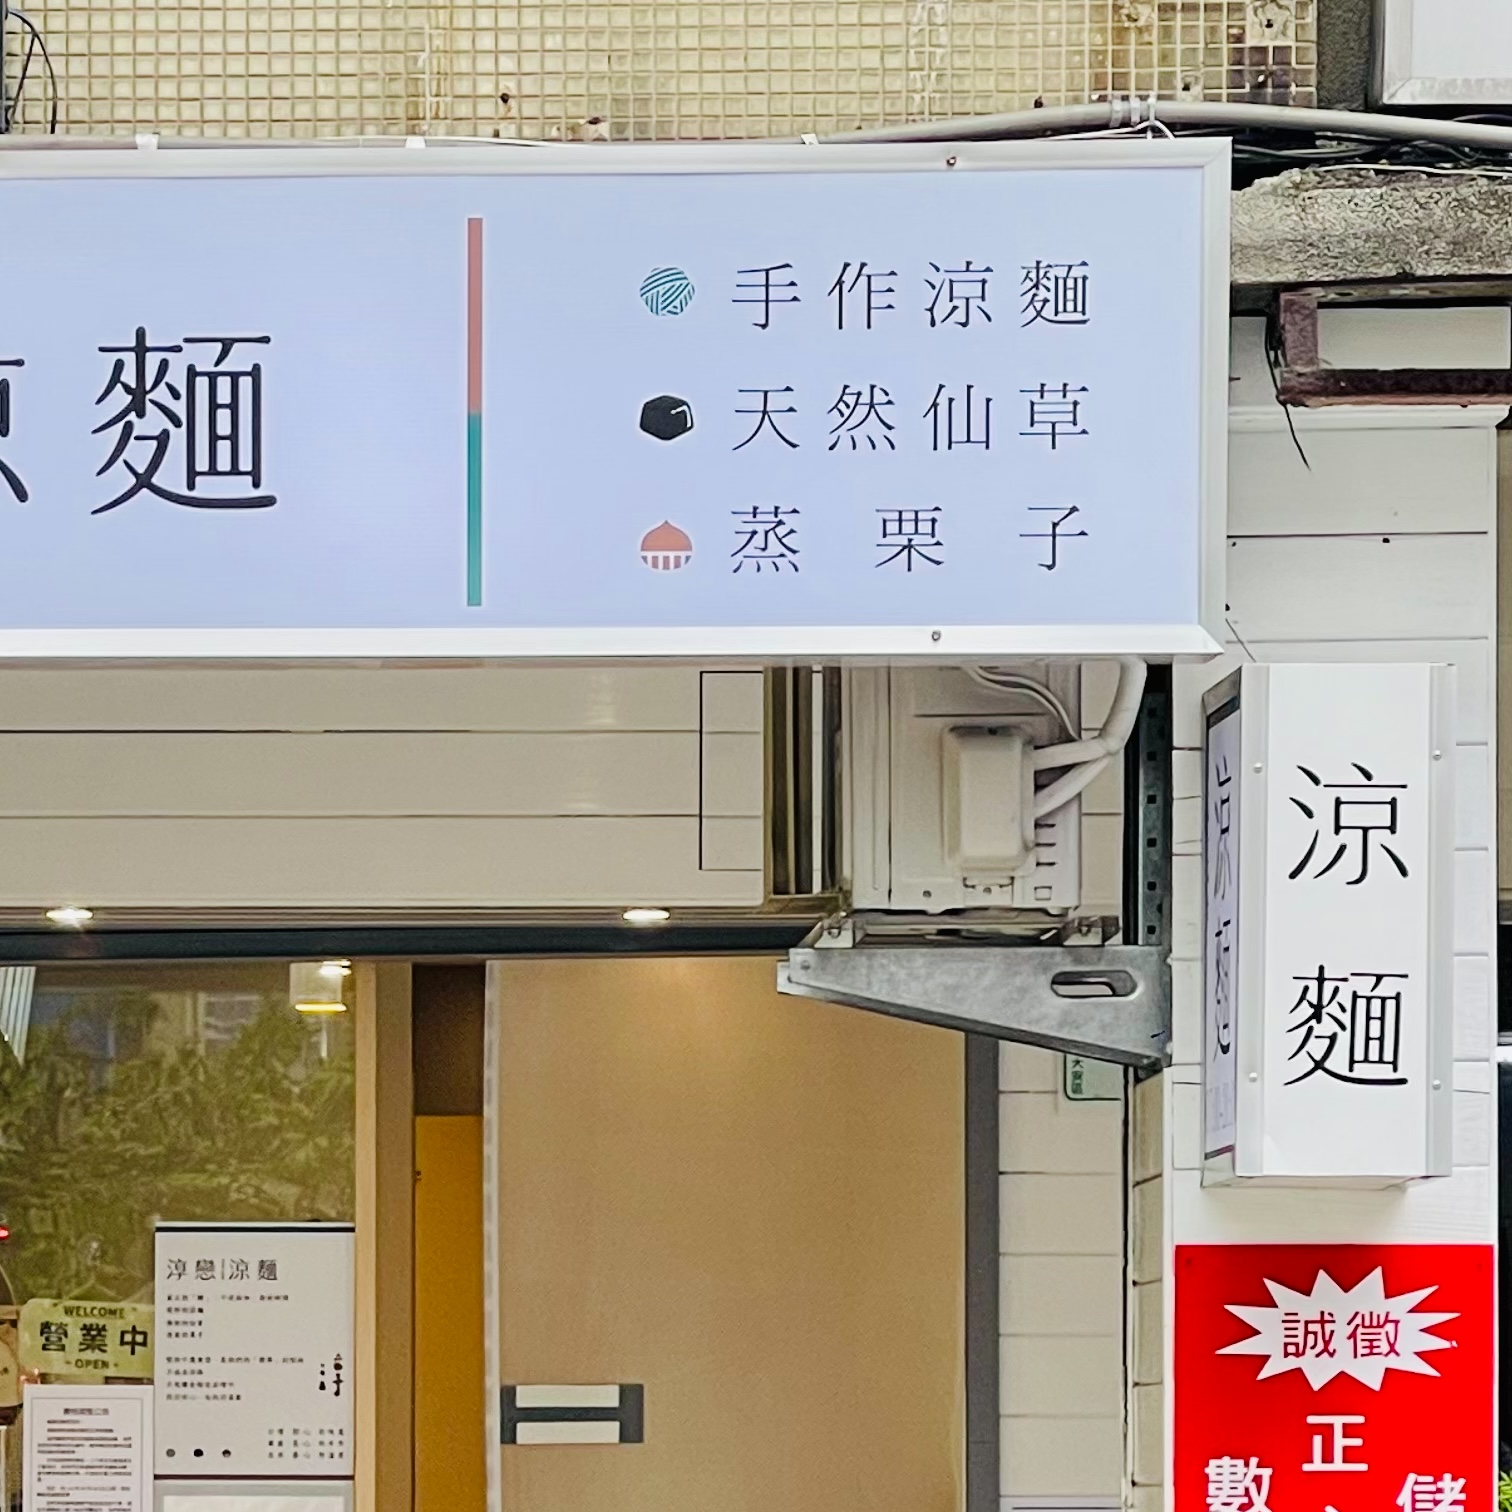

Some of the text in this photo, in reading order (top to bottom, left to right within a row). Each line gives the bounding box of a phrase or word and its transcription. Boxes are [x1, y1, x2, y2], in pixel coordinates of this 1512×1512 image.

[731, 260, 1090, 331] 手作涼麵
[731, 382, 1090, 451] 天然仙草
[730, 505, 1090, 574] 蒸栗子
[1283, 762, 1409, 1087] 涼麵
[39, 1320, 149, 1356] 營業中
[64, 1305, 126, 1319] WELCOME
[1281, 1310, 1401, 1359] 誠徵
[74, 1358, 110, 1370] OPEN
